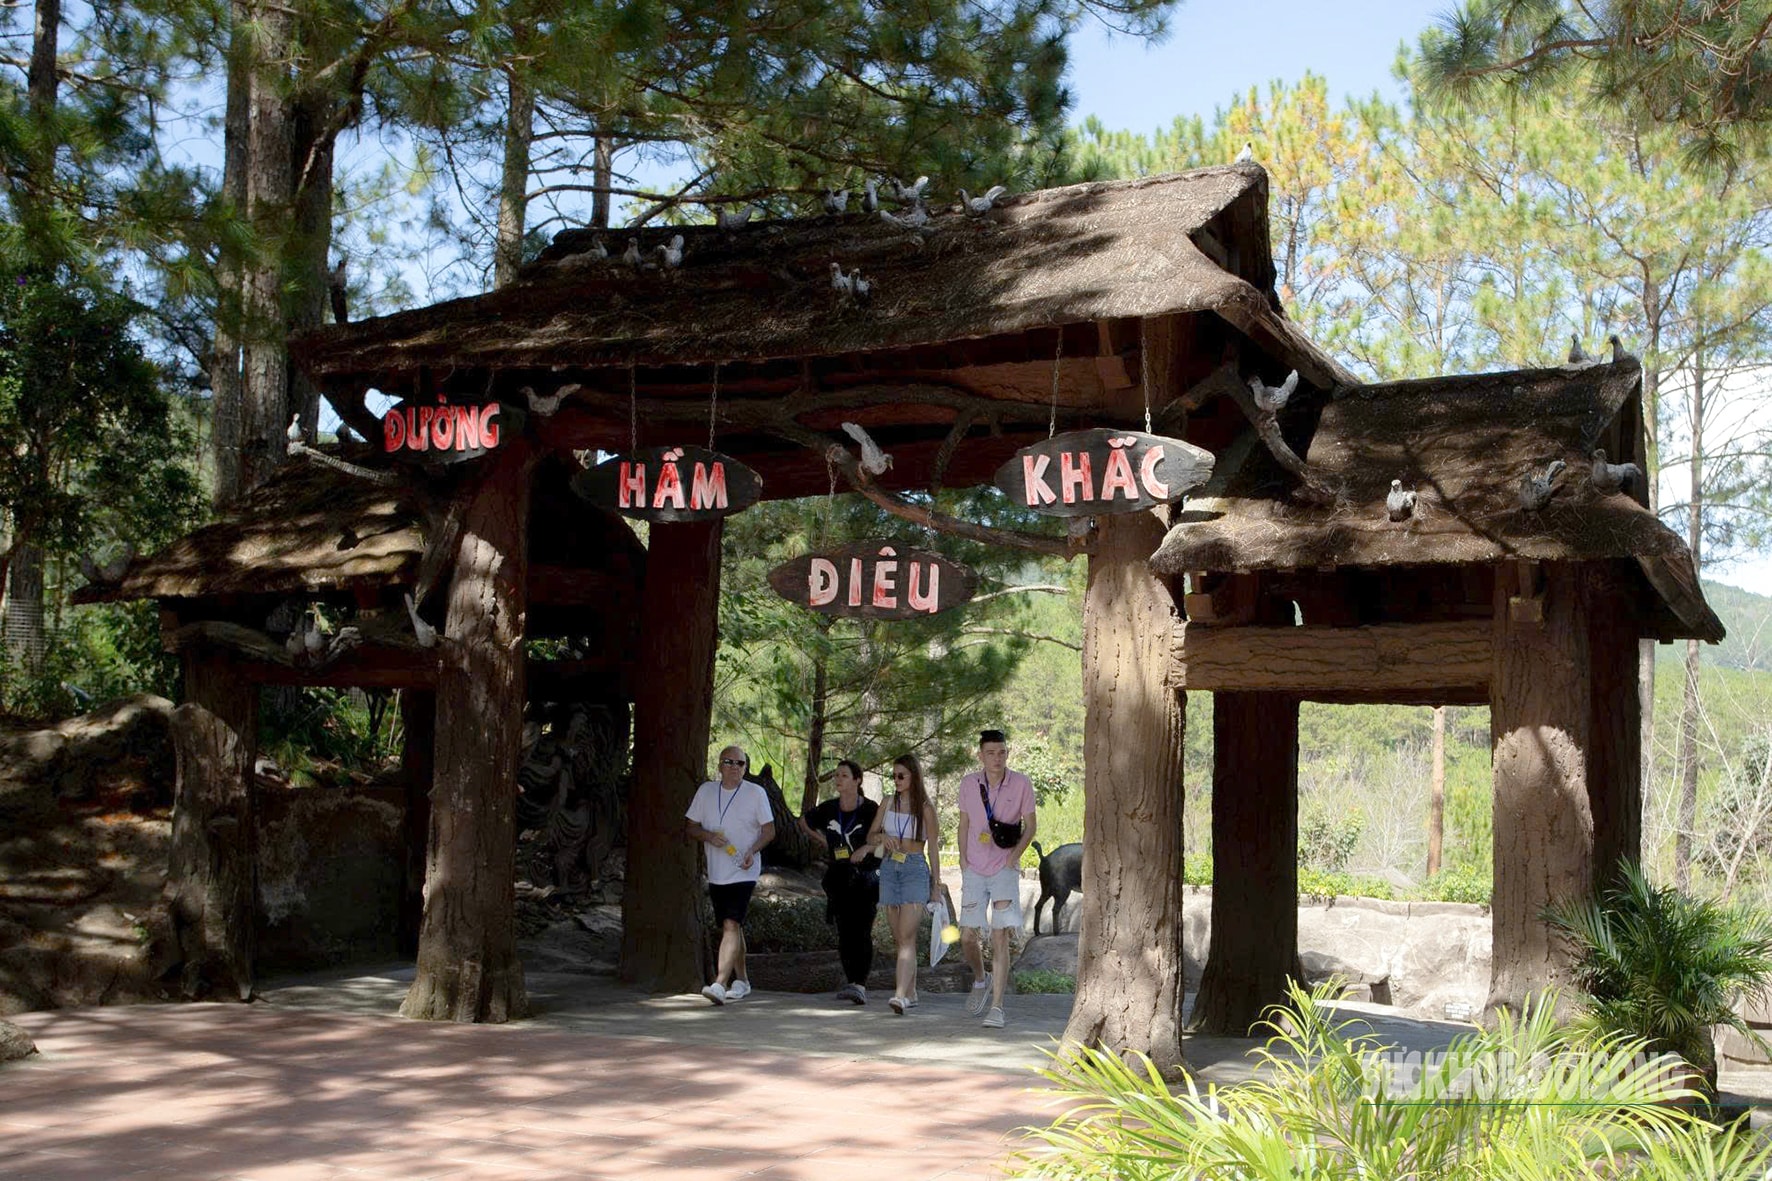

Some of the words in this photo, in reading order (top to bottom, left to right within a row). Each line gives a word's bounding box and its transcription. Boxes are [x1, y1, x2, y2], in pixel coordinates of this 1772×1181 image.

[384, 393, 500, 453] ĐƯỜNG
[619, 447, 728, 510] HẦM
[1022, 436, 1169, 505] KHẮC
[808, 546, 940, 613] ĐIÊU
